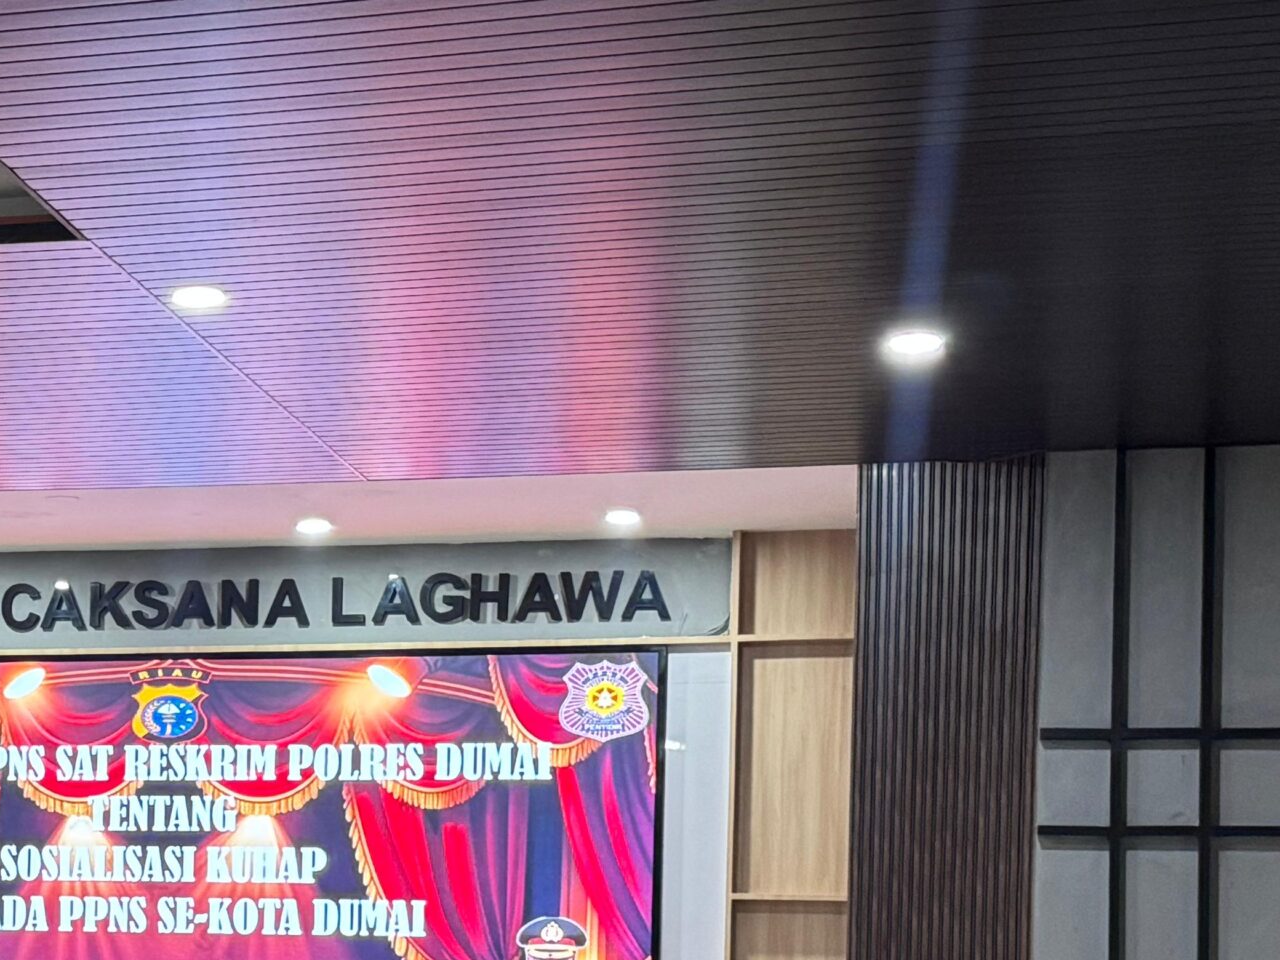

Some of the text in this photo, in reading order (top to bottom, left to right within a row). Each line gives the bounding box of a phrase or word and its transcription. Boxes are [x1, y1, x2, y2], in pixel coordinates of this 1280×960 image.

[331, 570, 672, 626] LAGHAWA
[138, 668, 203, 680] RIAU
[56, 745, 114, 782] SAT
[123, 744, 277, 781] RESKRIM
[287, 743, 423, 781] POLRES
[434, 742, 553, 781] DUMAI
[87, 795, 237, 832] TENTANG
[0, 844, 327, 885] SOSIALISASI KUHAP
[58, 896, 148, 933] PPNS
[157, 896, 304, 936] SE-KOTA
[312, 899, 427, 938] DUMAI
